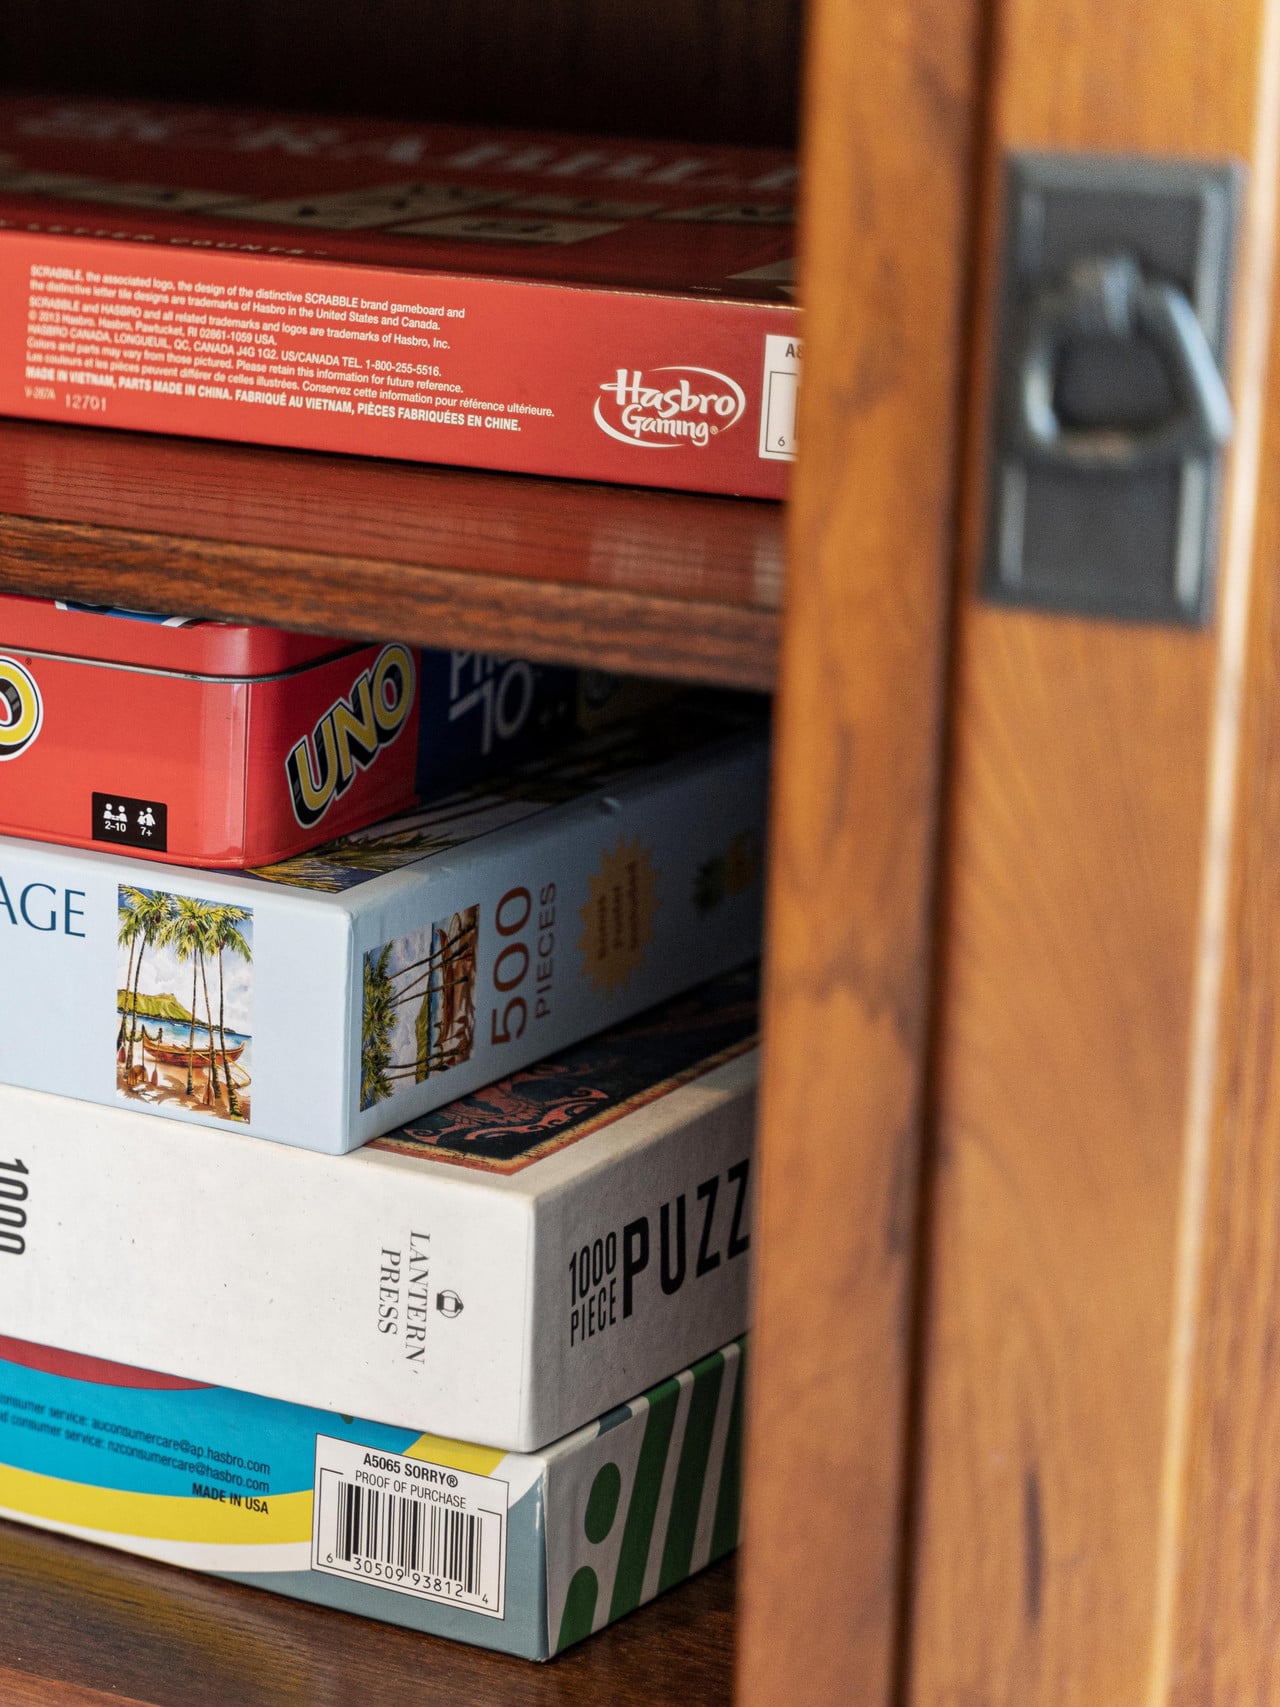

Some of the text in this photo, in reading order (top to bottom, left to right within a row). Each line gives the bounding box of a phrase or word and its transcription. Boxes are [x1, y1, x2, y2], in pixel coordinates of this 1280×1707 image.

[102, 274, 151, 288] associated
[153, 277, 174, 291] logo,
[177, 280, 192, 292] the
[194, 282, 224, 296] design
[227, 284, 236, 296] of
[238, 286, 253, 298] the
[255, 287, 302, 302] distinctive
[305, 292, 357, 308] SCRABBLE
[360, 298, 387, 311] brand
[390, 303, 444, 316] gameboard
[446, 307, 464, 318] and
[118, 287, 131, 300] tile
[133, 289, 168, 304] designs
[171, 294, 185, 305] are
[187, 295, 238, 310] trademarks
[241, 300, 250, 311] of
[252, 301, 285, 315] Hasbro
[288, 304, 296, 316] in
[298, 306, 313, 318] the
[316, 307, 346, 321] United
[349, 310, 378, 324] States
[380, 315, 398, 326] and
[401, 315, 439, 330] Canada.
[135, 319, 184, 336] Pawtucket,
[187, 325, 197, 337] RI
[254, 333, 276, 346] USA.
[143, 309, 160, 320] and
[162, 309, 173, 321] all
[175, 312, 206, 324] related
[208, 315, 259, 330] trademarks
[262, 321, 279, 332] and
[282, 321, 307, 335] logos
[309, 326, 324, 336] are
[327, 327, 379, 342] trademarks
[381, 332, 391, 343] of
[394, 333, 429, 348] Hasbro,
[433, 336, 449, 349] Inc.
[122, 349, 141, 361] vary
[143, 349, 164, 361] from
[166, 351, 191, 365] those
[193, 356, 232, 369] pictured.
[236, 358, 266, 373] Please
[269, 364, 294, 375] retain
[297, 365, 314, 378] this
[316, 367, 368, 383] information
[371, 373, 384, 385] for
[386, 374, 413, 388] future
[416, 379, 462, 393] reference.
[193, 340, 234, 355] CANADA
[236, 345, 254, 357] J4G
[258, 347, 277, 360] 1G2.
[281, 350, 339, 366] US/CANADA
[342, 355, 362, 368] TEL.
[366, 359, 440, 376] 1-800-255-5516.
[65, 393, 107, 412] 12701
[110, 357, 139, 373] pièces
[141, 364, 177, 377] peuvent
[179, 367, 211, 380] différer
[213, 370, 225, 382] de
[227, 373, 254, 385] celles
[256, 375, 298, 390] illustrées.
[302, 379, 350, 396] Conservez
[353, 387, 376, 398] cette
[379, 388, 432, 404] information
[435, 396, 457, 407] pour
[459, 397, 504, 411] référence
[507, 402, 553, 417] ultérieure.
[118, 375, 151, 391] PARTS
[153, 379, 182, 395] MADE
[184, 383, 195, 396] IN
[197, 384, 232, 400] CHINA.
[235, 388, 286, 406] FABRIQUÉ
[288, 394, 302, 408] AU
[305, 396, 354, 415] VIETNAM,
[357, 401, 394, 418] PIÈCES
[398, 406, 464, 425] FABRIQUÉES
[467, 413, 481, 427] EN
[484, 415, 520, 431] CHINE.
[600, 368, 735, 417] Hasbro
[287, 644, 413, 828] UNO
[104, 820, 127, 832] 2-10
[140, 826, 152, 837] 7+
[491, 886, 531, 1045] 500
[535, 882, 557, 1019] PIECES
[623, 1158, 751, 1320] PUZZ
[378, 1247, 401, 1335] PRESS
[569, 1231, 617, 1307] 1000
[405, 1230, 431, 1365] LANTERN
[570, 1277, 617, 1347] PIECE
[11, 1414, 61, 1437] consumer
[65, 1428, 102, 1448] service:
[49, 1406, 86, 1426] service:
[363, 1453, 401, 1474] A5065
[192, 1482, 269, 1514] MADE IN USA
[355, 1470, 467, 1509] PROOF OF PURCHASE
[326, 1552, 489, 1605] 6 30509 93812 4
